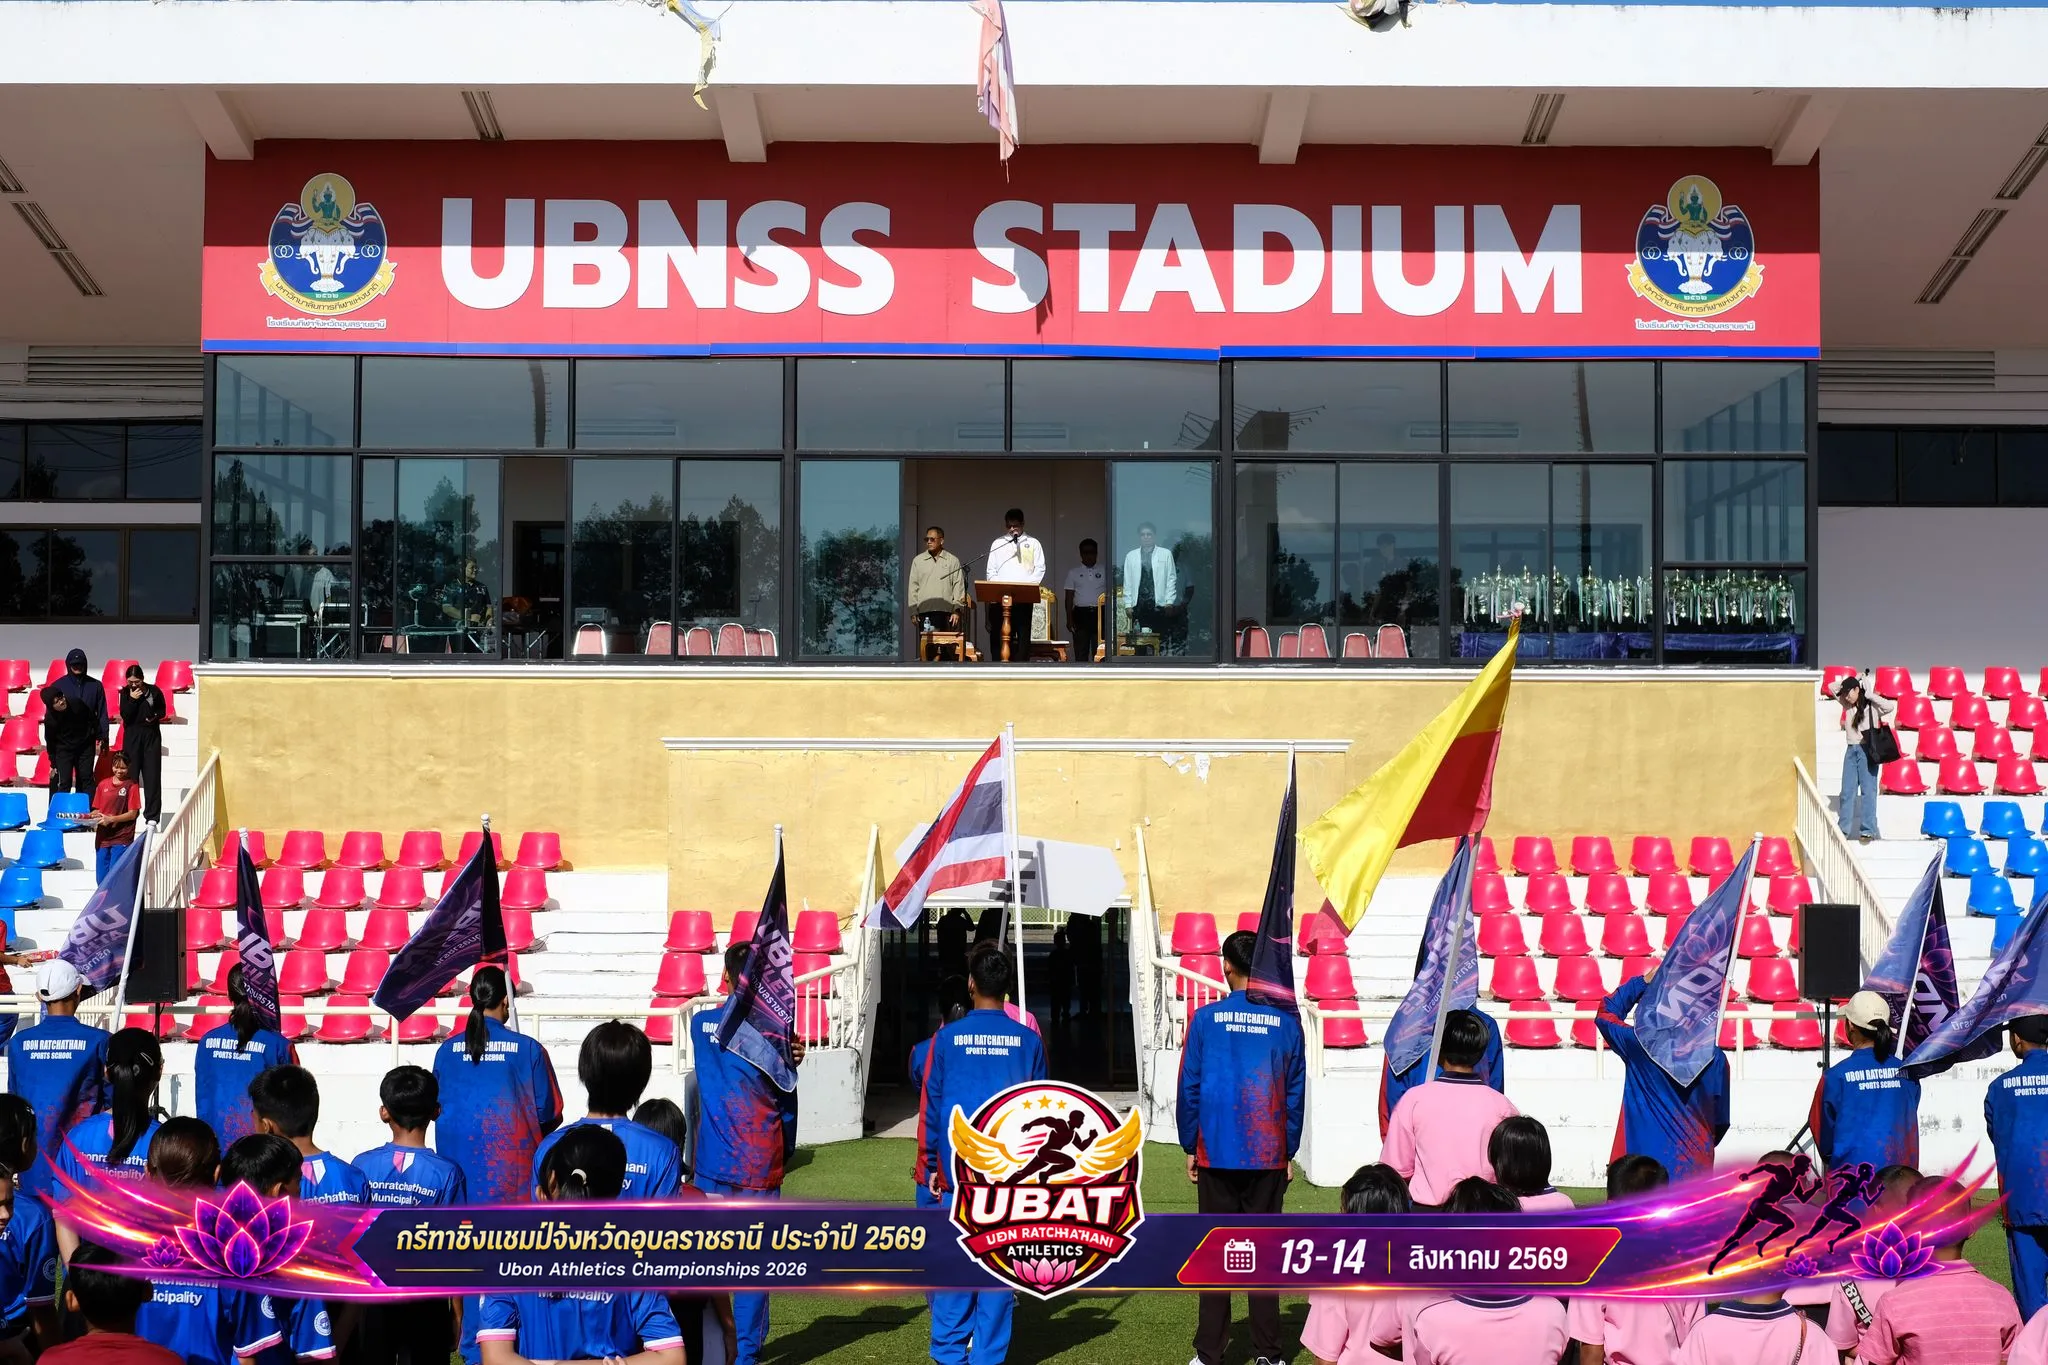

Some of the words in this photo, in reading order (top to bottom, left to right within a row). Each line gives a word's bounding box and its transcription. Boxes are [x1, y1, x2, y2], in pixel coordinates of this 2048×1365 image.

[441, 198, 895, 315] UBNSS
[972, 200, 1583, 316] STADIUM
[1213, 1011, 1233, 1023] UBON
[1234, 1012, 1281, 1028] RATCHATHANI
[1226, 1024, 1246, 1033] SPORTS
[1247, 1026, 1268, 1035] SCHOOL
[40, 1039, 87, 1051] RATCHATHANI
[221, 1039, 266, 1054] RATCTHANI
[954, 1034, 973, 1046] UBON
[974, 1034, 1021, 1047] RATCHATHANI
[452, 1041, 466, 1053] UBO
[966, 1047, 987, 1055] SPORTS
[988, 1048, 1009, 1056] SCHOOL
[30, 1052, 51, 1060] SPORTS
[51, 1052, 72, 1060] SCHOOL
[213, 1050, 232, 1059] SPORTS
[484, 1053, 506, 1062] SCHOOL
[1844, 1070, 1865, 1082] UBON
[1858, 1081, 1880, 1090] SPORTS
[1880, 1080, 1901, 1089] SCHOOL
[2003, 1076, 2021, 1089] UBON
[2014, 1088, 2036, 1097] SPORTS
